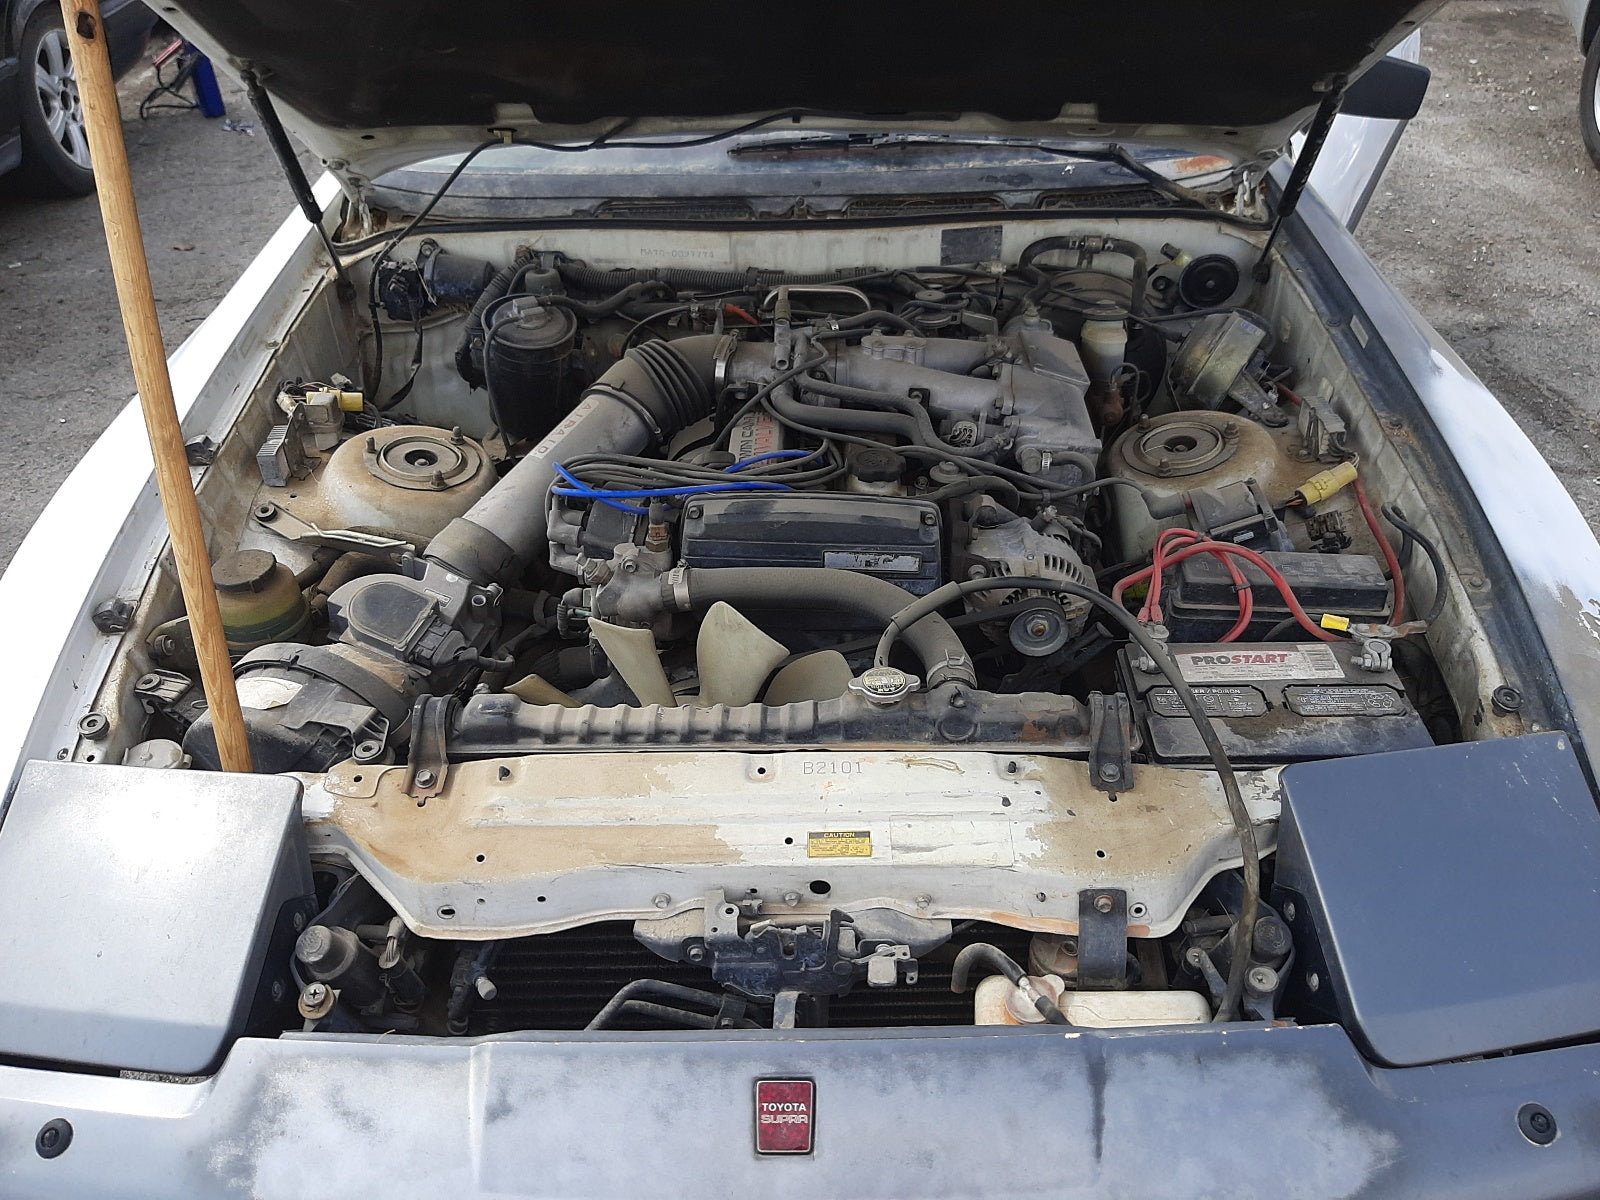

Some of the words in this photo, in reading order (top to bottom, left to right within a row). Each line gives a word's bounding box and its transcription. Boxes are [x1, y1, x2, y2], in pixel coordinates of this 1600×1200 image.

[1191, 653, 1288, 666] PROSTART
[803, 761, 863, 775] B2101
[762, 1102, 807, 1112] TOYOTA
[760, 1114, 809, 1124] SUPRA
